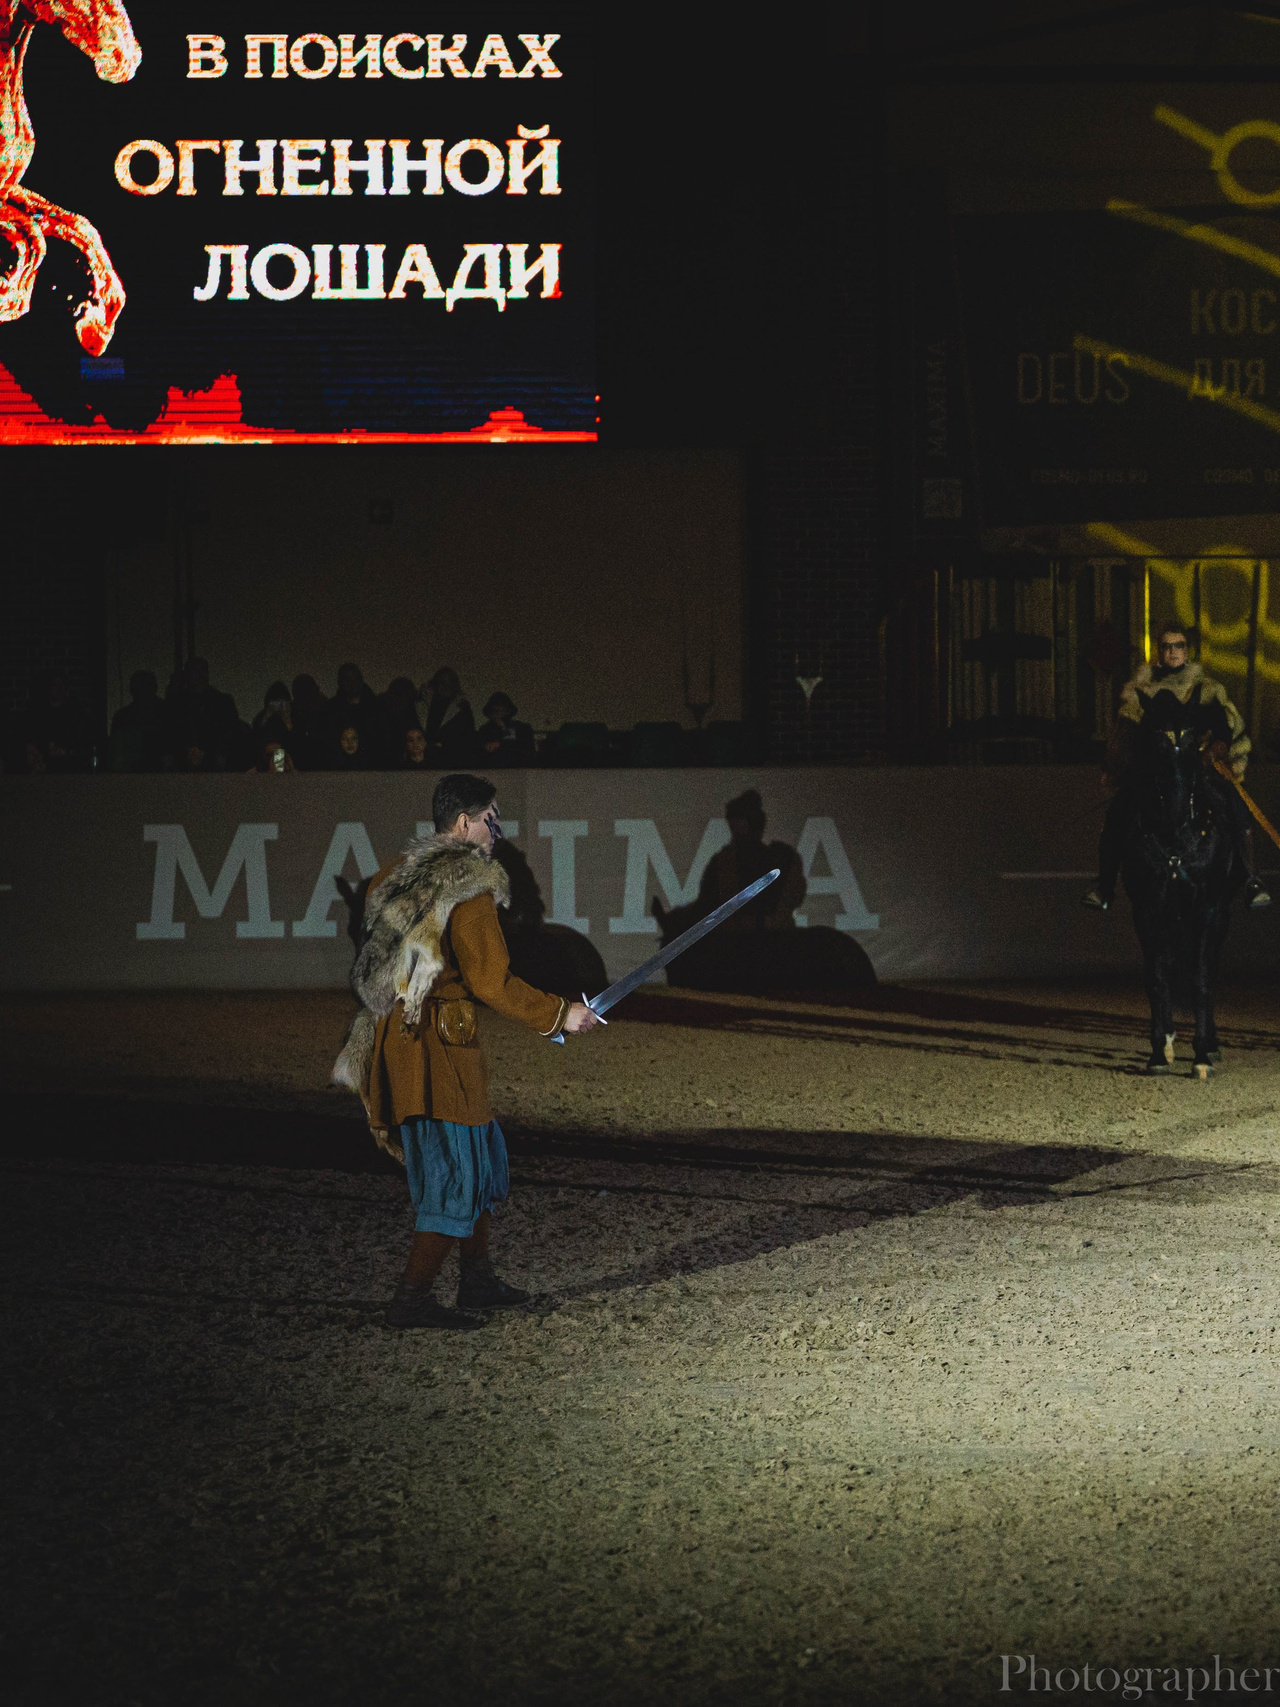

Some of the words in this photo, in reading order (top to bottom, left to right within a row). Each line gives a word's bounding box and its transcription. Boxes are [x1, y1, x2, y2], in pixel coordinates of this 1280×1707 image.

[186, 34, 229, 79] В
[244, 33, 563, 80] ПОИСКАХ
[114, 124, 563, 197] ОГНЕННОЙ
[193, 243, 563, 312] ЛОШАДИ
[1017, 352, 1131, 405] DEUS
[1187, 357, 1266, 400] ДЛЯ
[136, 816, 881, 940] MAIMA
